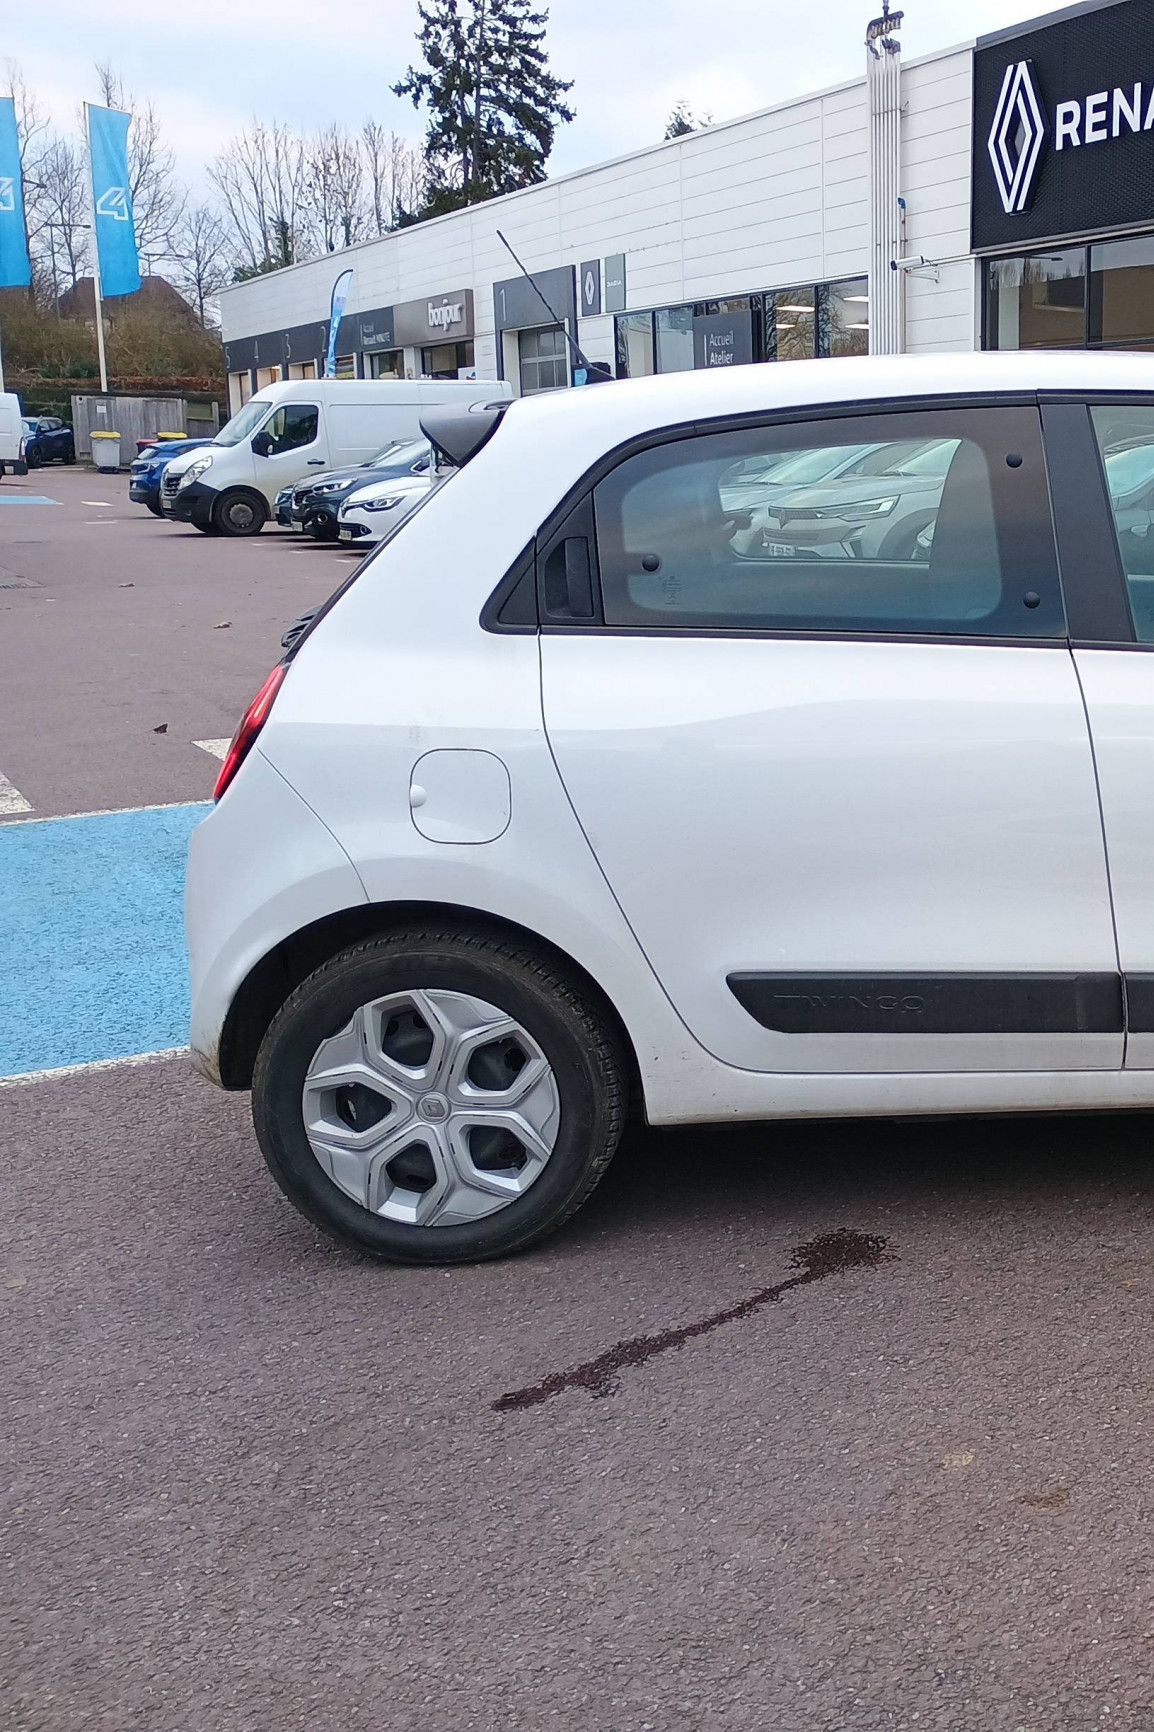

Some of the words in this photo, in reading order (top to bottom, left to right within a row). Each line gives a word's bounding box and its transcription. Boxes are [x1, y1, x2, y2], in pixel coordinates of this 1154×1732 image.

[499, 288, 507, 322] 1
[427, 298, 463, 332] bonjour
[709, 330, 734, 347] Accueil
[709, 350, 734, 366] Atelier
[773, 995, 925, 1013] TWINGO
